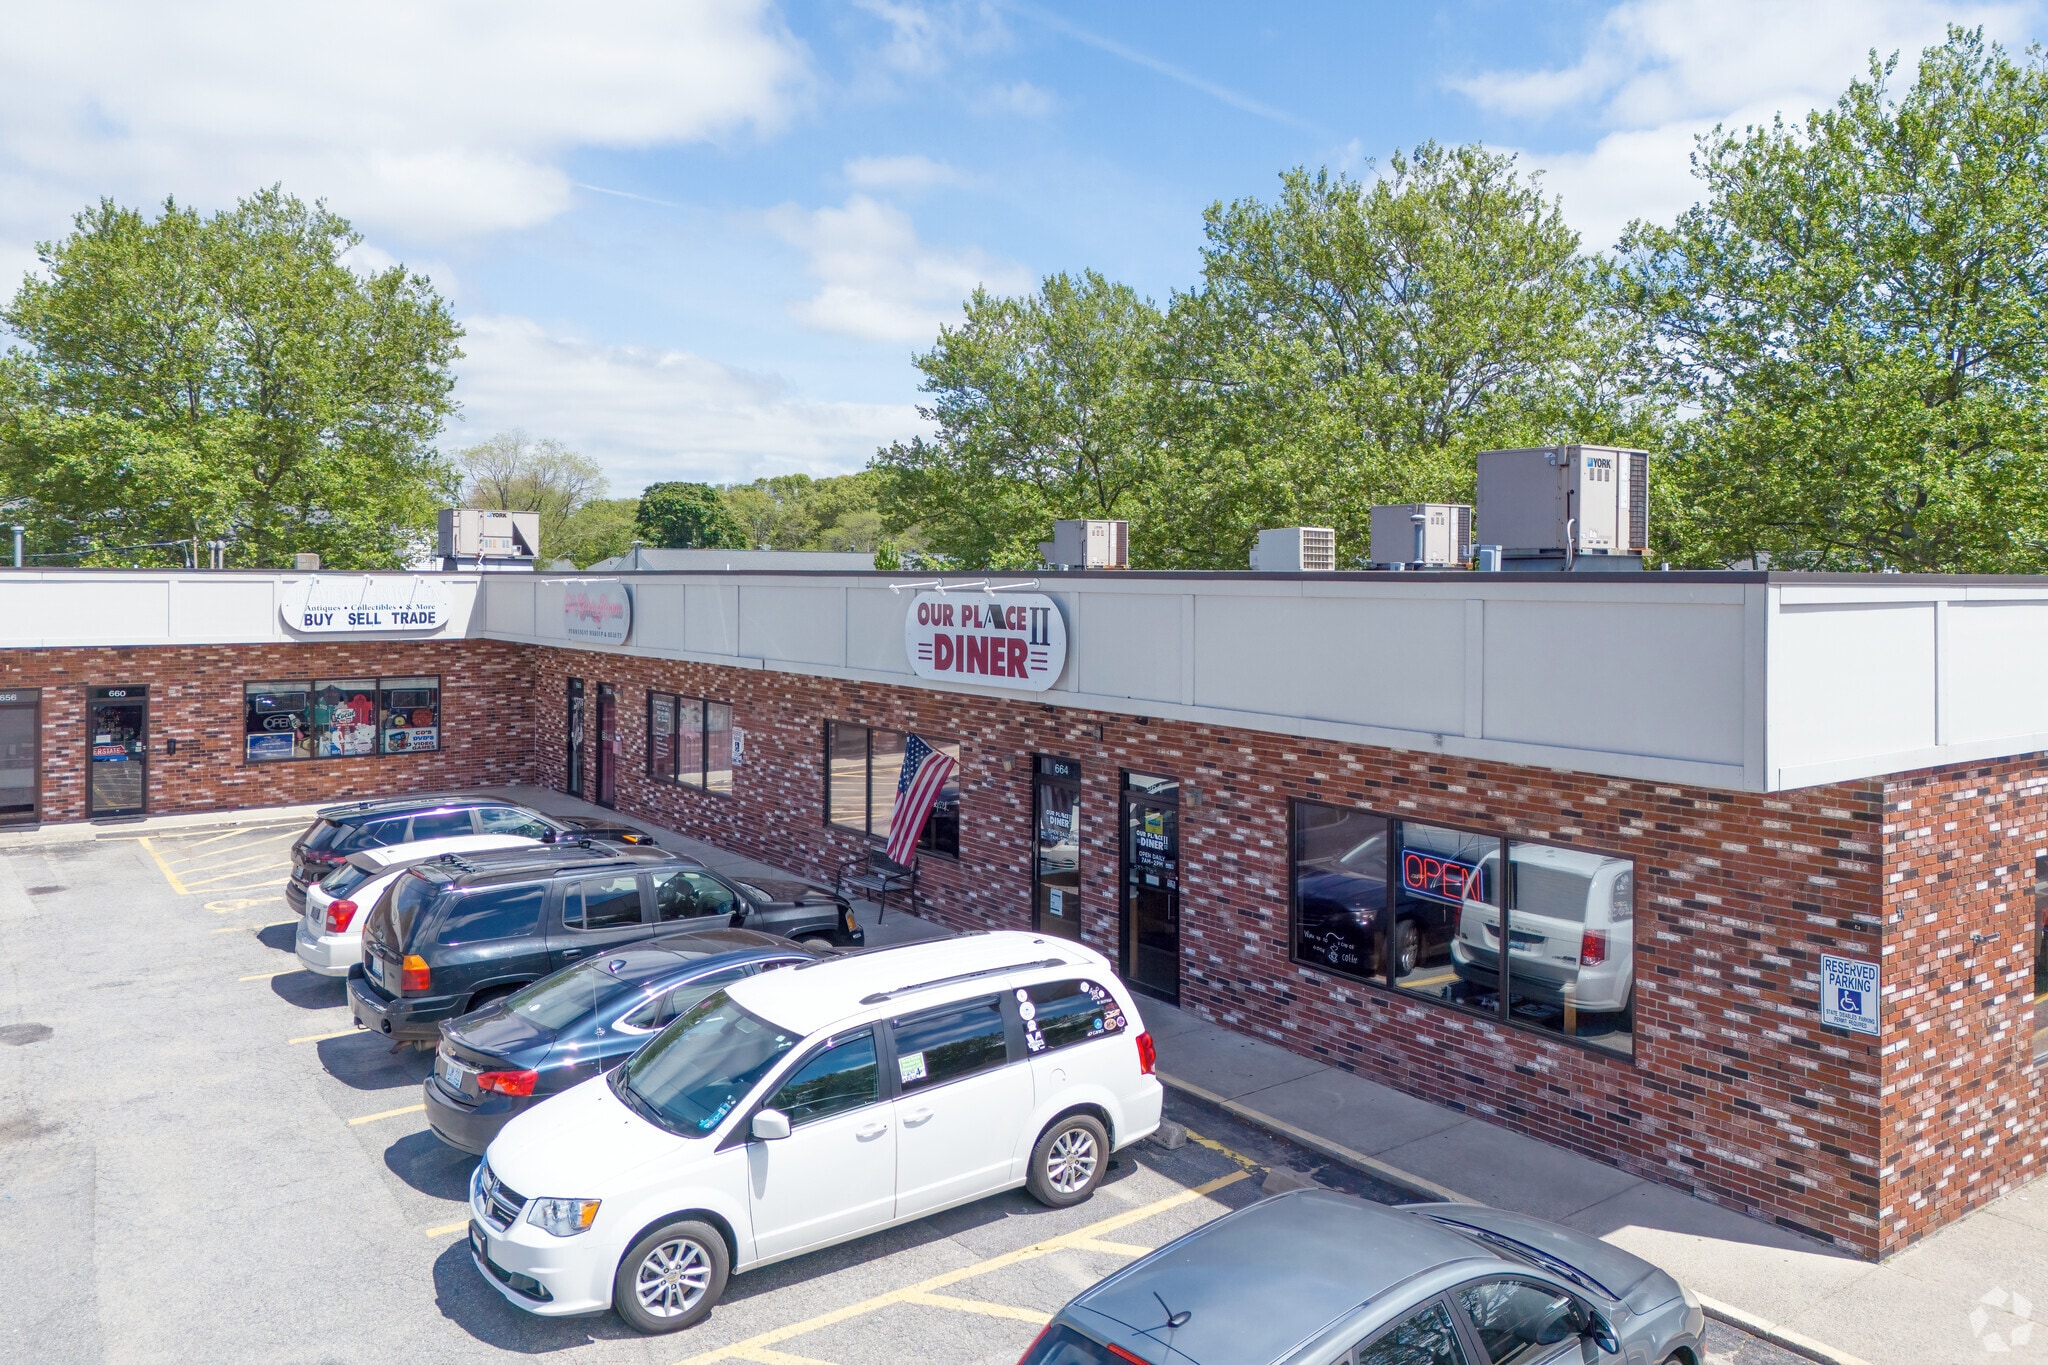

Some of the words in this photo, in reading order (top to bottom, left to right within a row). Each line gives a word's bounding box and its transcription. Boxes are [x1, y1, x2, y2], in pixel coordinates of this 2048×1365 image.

[1593, 458, 1611, 469] YORK
[305, 604, 341, 612] Antiques
[350, 603, 397, 611] Collectibles
[304, 613, 334, 626] BUY
[348, 612, 382, 625] SELL
[391, 611, 436, 624] TRADE
[917, 602, 954, 627] OUR
[961, 604, 1026, 631] PLACE
[1029, 606, 1050, 646] II
[934, 633, 1029, 679] DINER
[0, 693, 17, 701] 656
[1054, 764, 1069, 775] 664
[1049, 815, 1070, 828] DINER
[1140, 837, 1164, 851] DINER
[1138, 850, 1151, 858] OPEN
[1152, 853, 1166, 861] DAILY
[1405, 854, 1480, 903] OPEN
[1825, 959, 1876, 980] RESERVED
[1829, 973, 1871, 992] PARKING
[1825, 1008, 1838, 1016] STATE
[1839, 1011, 1857, 1020] DISABLED
[1858, 1016, 1875, 1025] PARKING
[1833, 1016, 1847, 1024] PERMIT
[1848, 1019, 1868, 1029] REQUIRED
